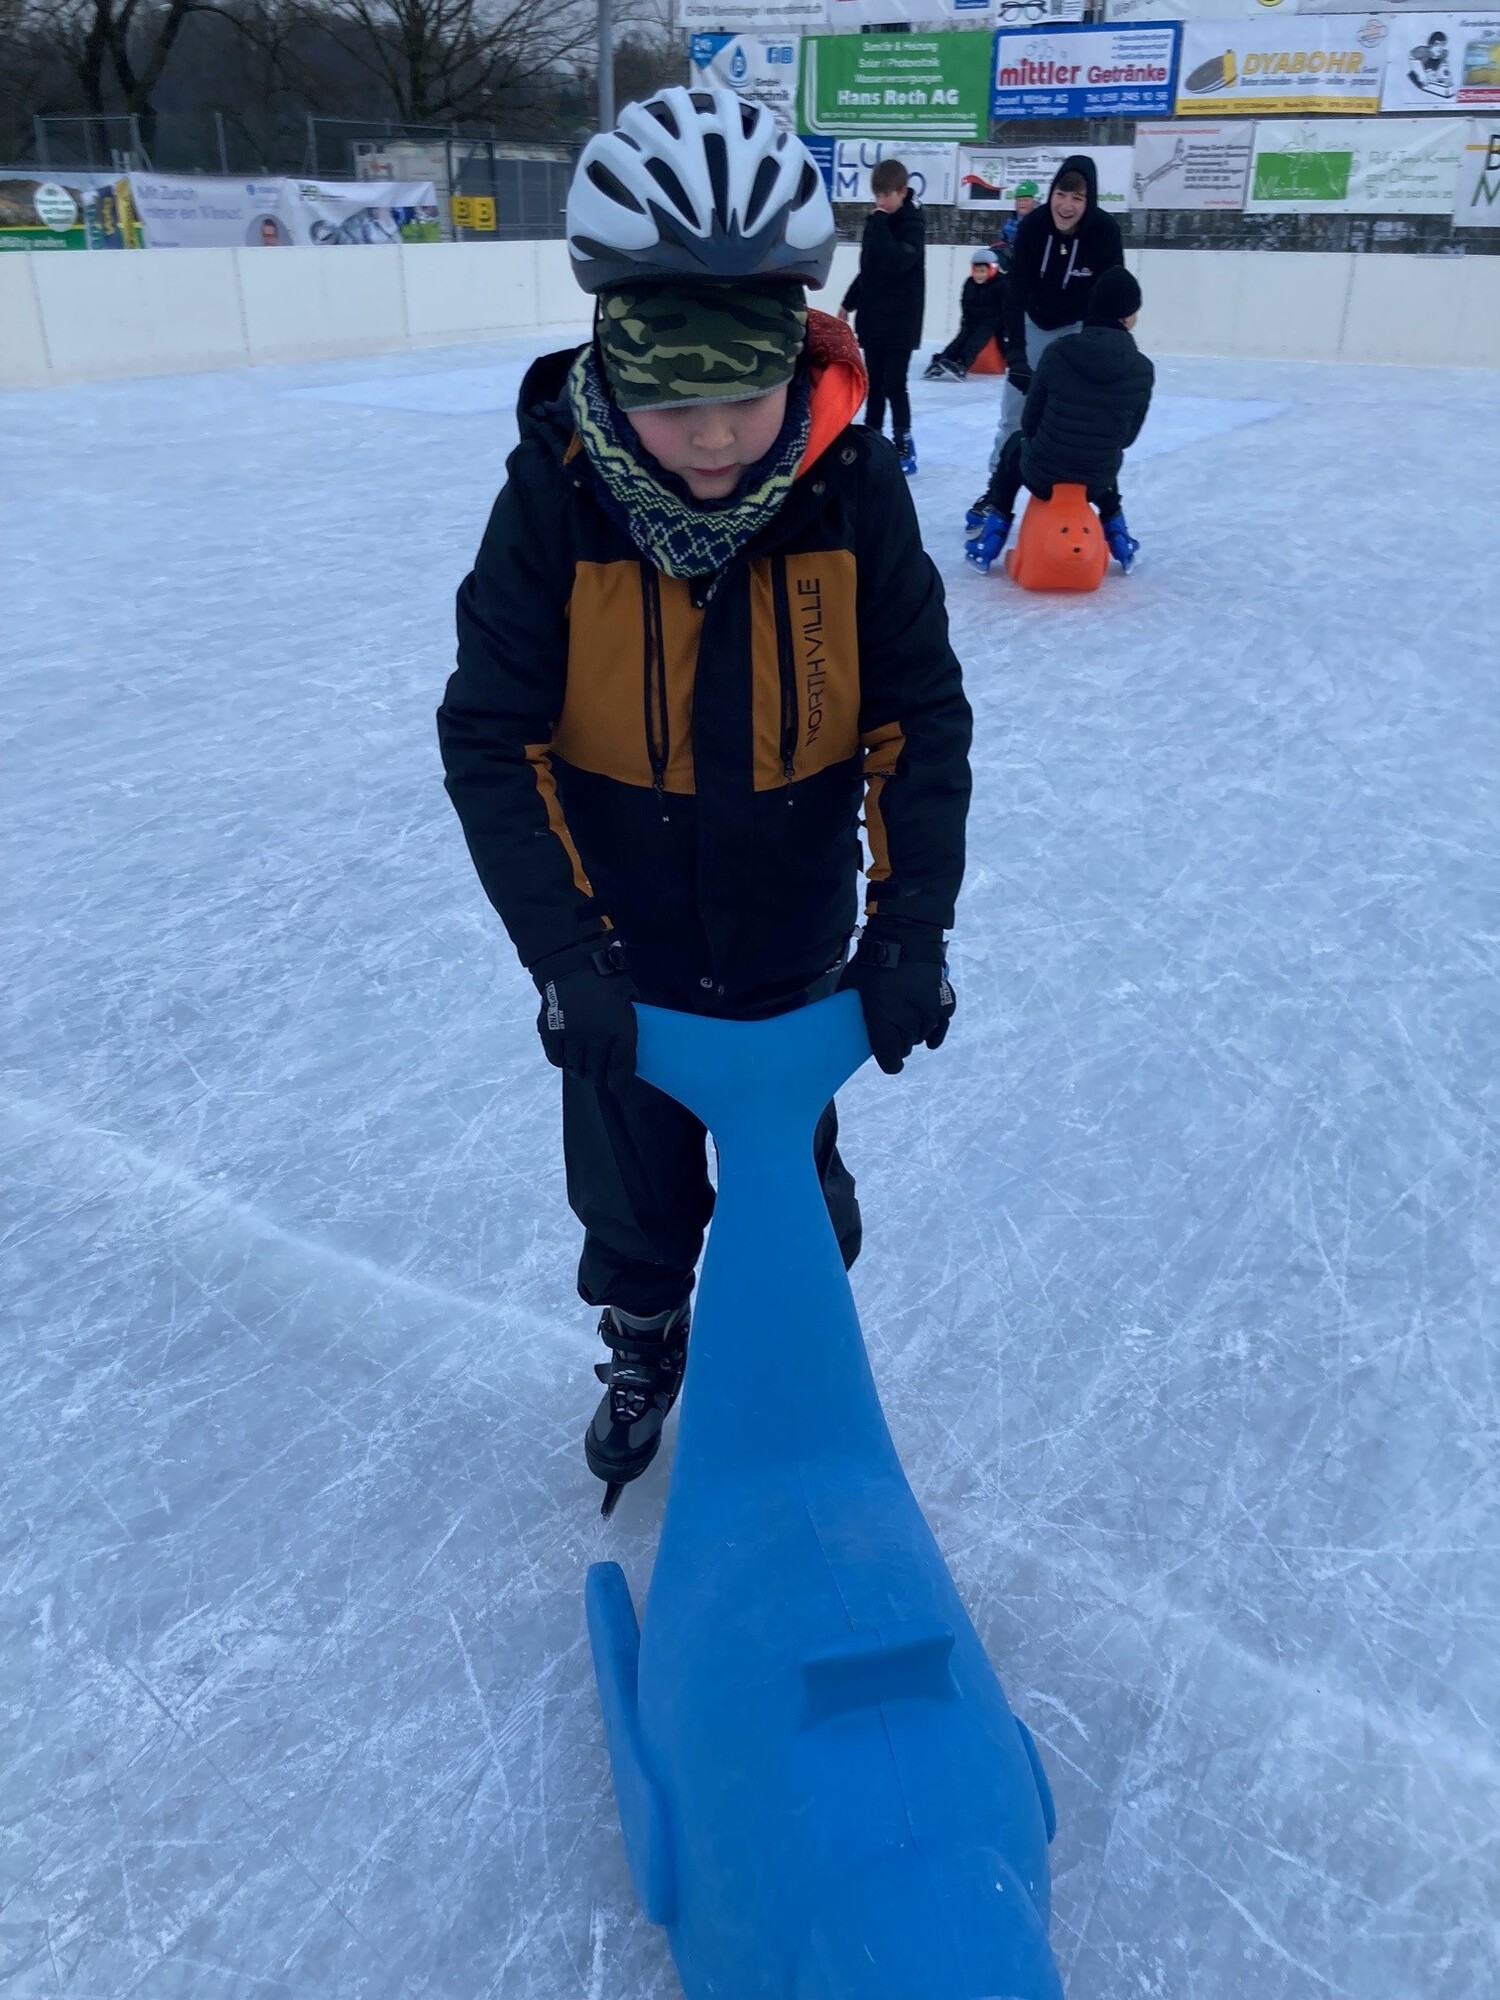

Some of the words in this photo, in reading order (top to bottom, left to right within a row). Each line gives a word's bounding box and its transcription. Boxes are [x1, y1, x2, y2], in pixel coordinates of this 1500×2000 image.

[1000, 57, 1081, 87] mittler
[1087, 64, 1167, 84] Getränke
[1241, 51, 1365, 75] DYABOHR
[837, 89, 881, 106] Hans
[884, 89, 927, 105] Roth
[930, 88, 960, 105] AG
[797, 578, 826, 747] NORTHVILLE
